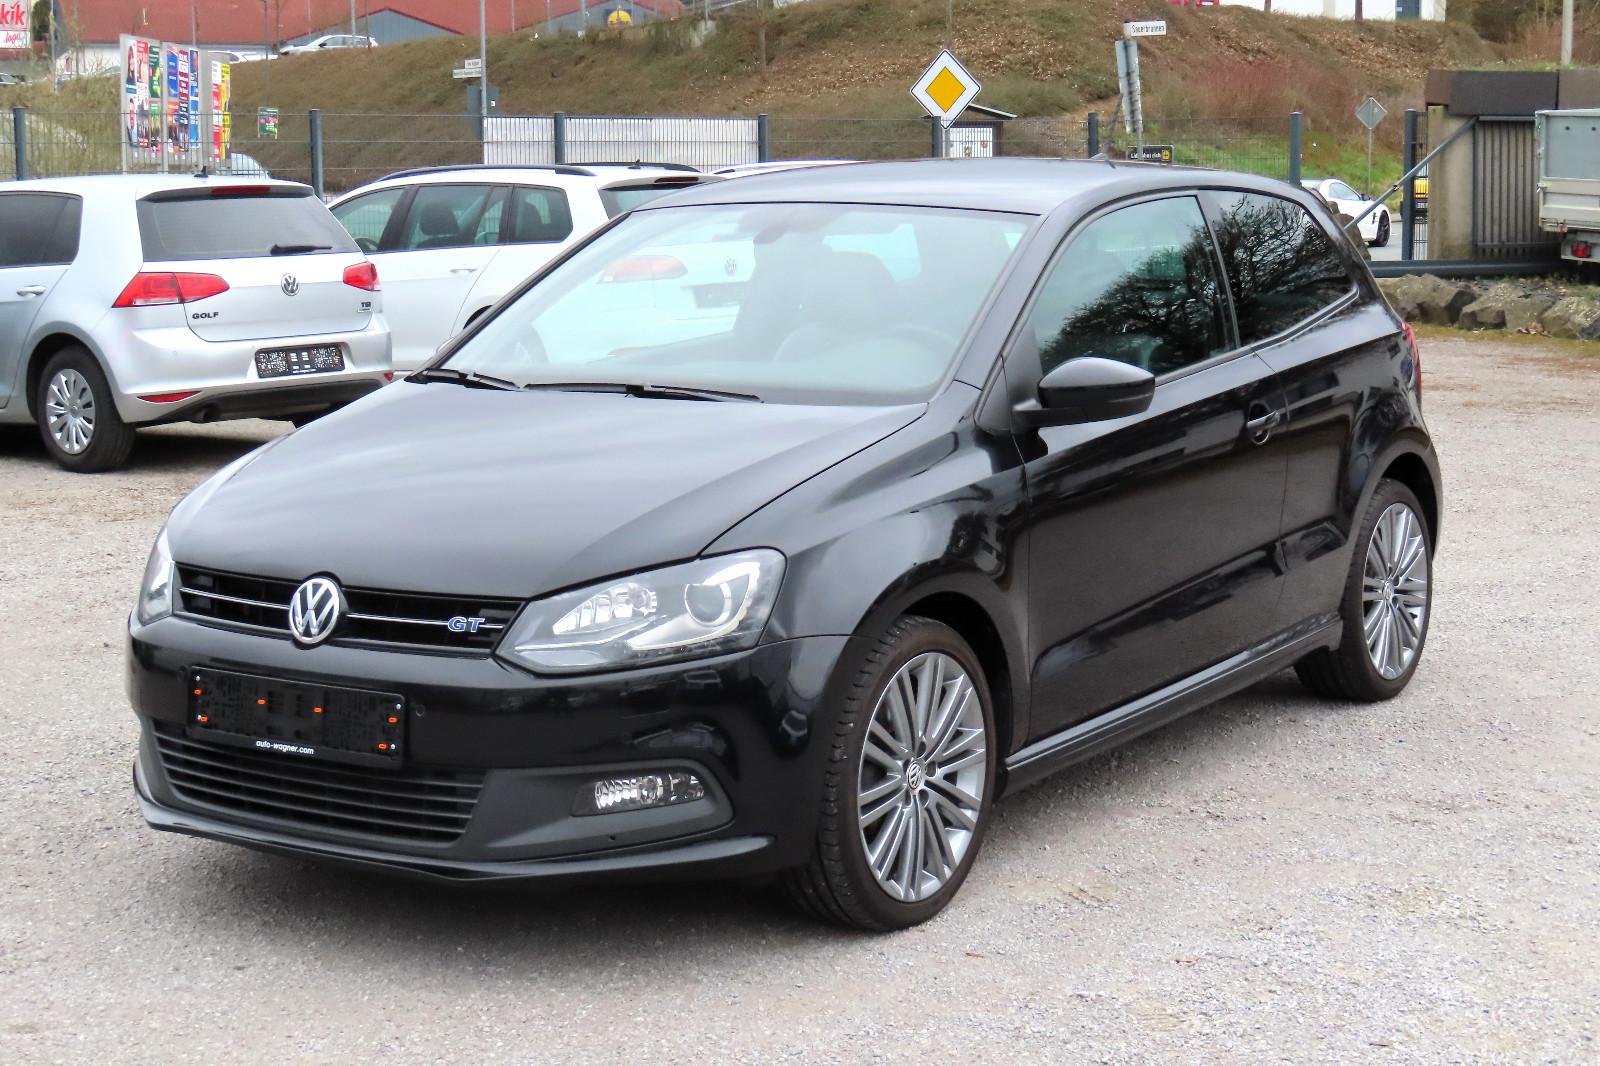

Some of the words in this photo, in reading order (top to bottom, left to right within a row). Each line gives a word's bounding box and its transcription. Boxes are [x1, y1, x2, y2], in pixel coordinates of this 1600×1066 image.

[289, 578, 340, 645] VW
[448, 616, 485, 633] GT
[255, 740, 314, 755] auto-wagner.com
